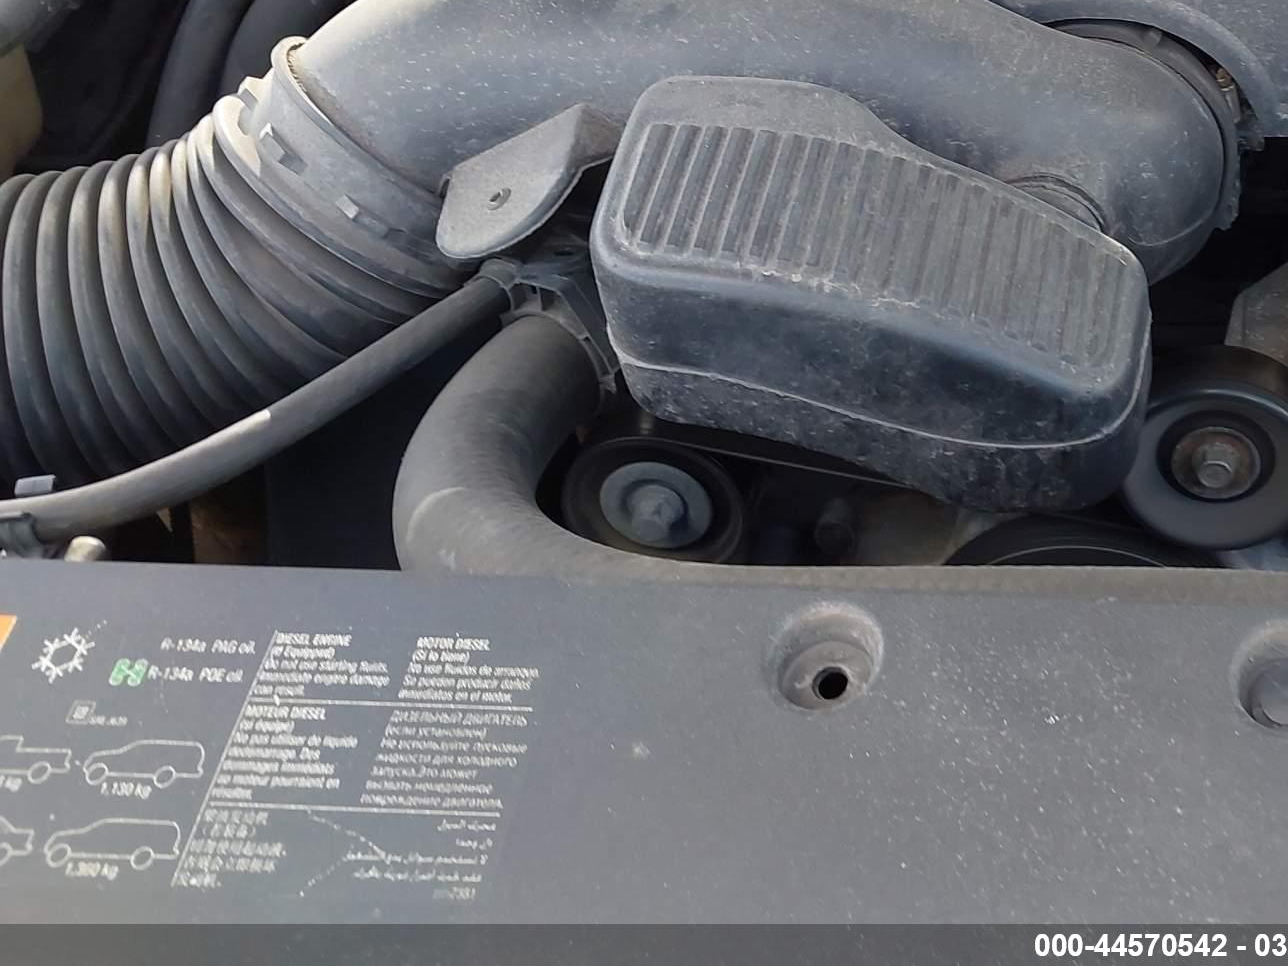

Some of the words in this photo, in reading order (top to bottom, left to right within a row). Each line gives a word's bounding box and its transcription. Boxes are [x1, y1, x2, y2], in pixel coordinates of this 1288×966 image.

[161, 636, 206, 653] R-134a
[212, 637, 239, 654] PAG
[276, 633, 312, 645] DIESEL
[313, 634, 352, 647] ENGINE
[417, 636, 454, 649] MOTOR
[454, 638, 491, 651] DIESEL
[148, 666, 194, 682] R-134a
[199, 667, 226, 682] POE
[247, 705, 290, 718] MOTEUR
[290, 707, 326, 720] DIESEL
